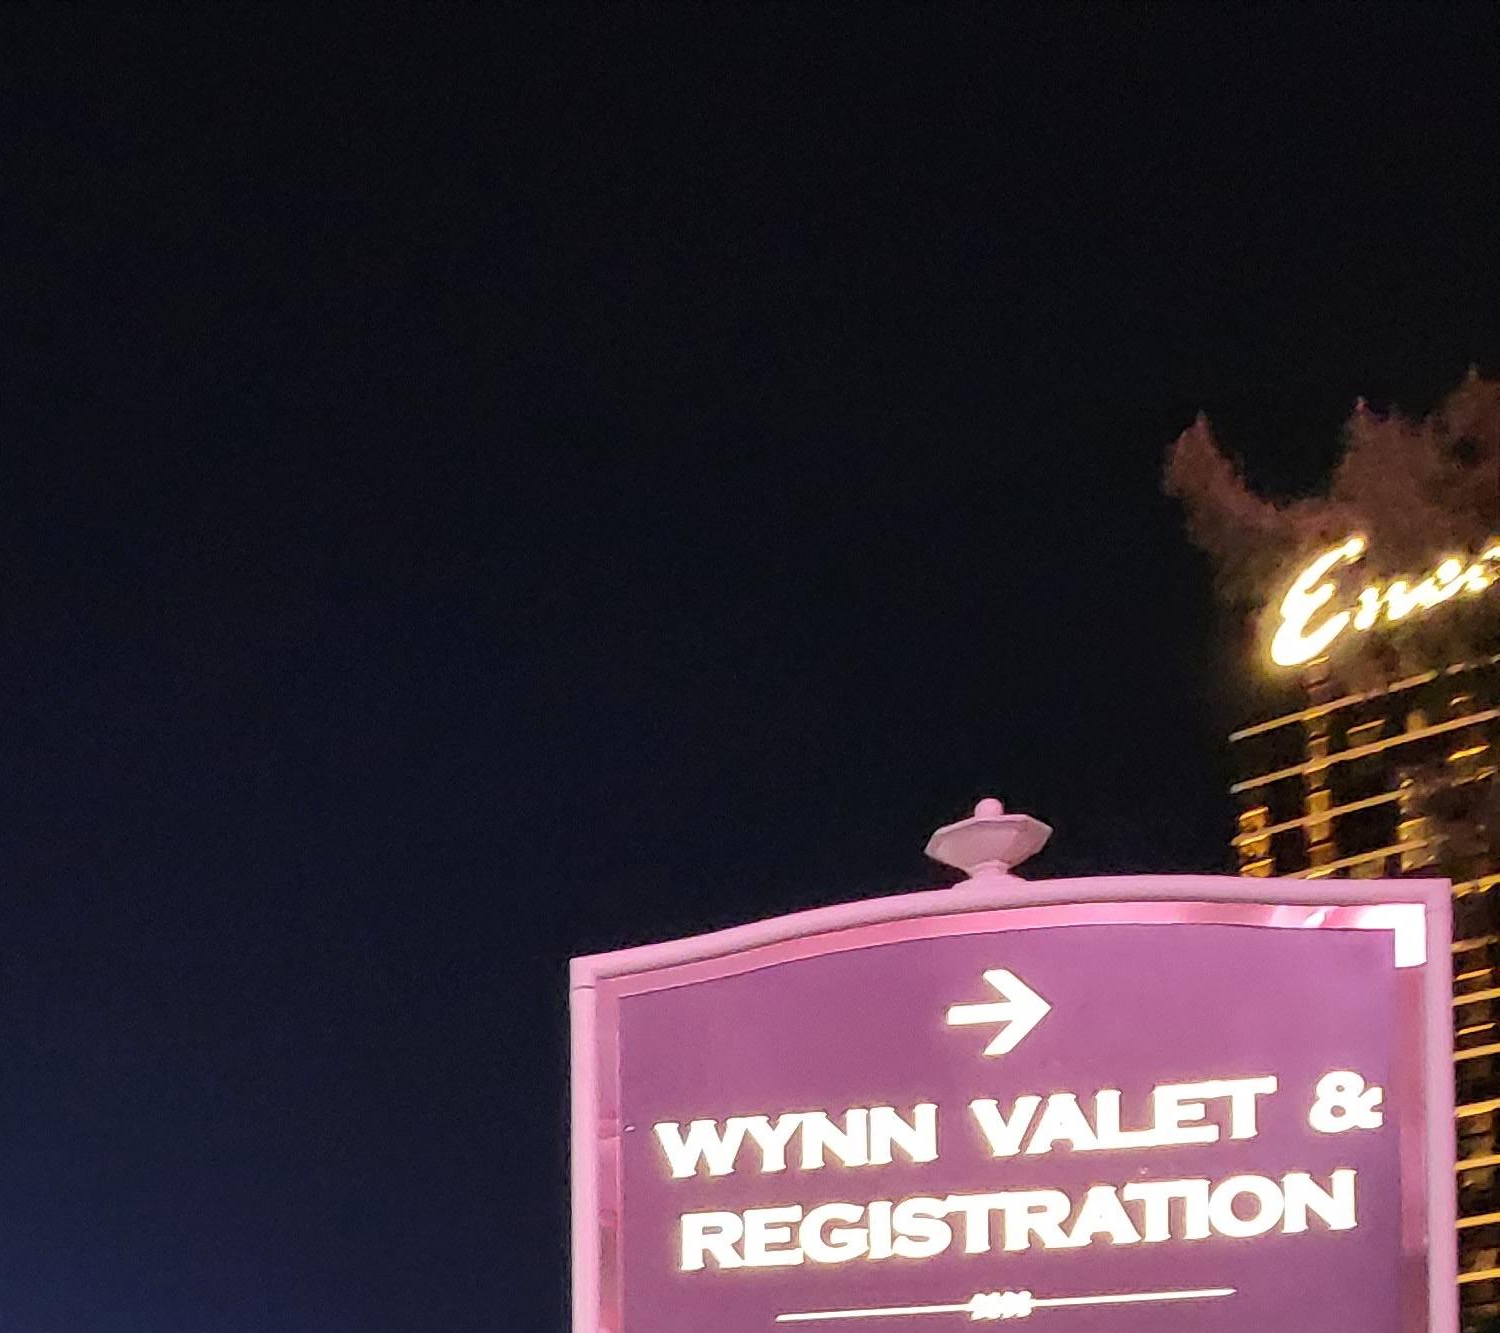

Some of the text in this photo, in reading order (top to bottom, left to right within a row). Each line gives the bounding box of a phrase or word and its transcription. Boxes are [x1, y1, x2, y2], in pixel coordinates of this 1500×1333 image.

[653, 1069, 1385, 1180] WYNN VALET &
[679, 1168, 1359, 1272] REGISTRATION
